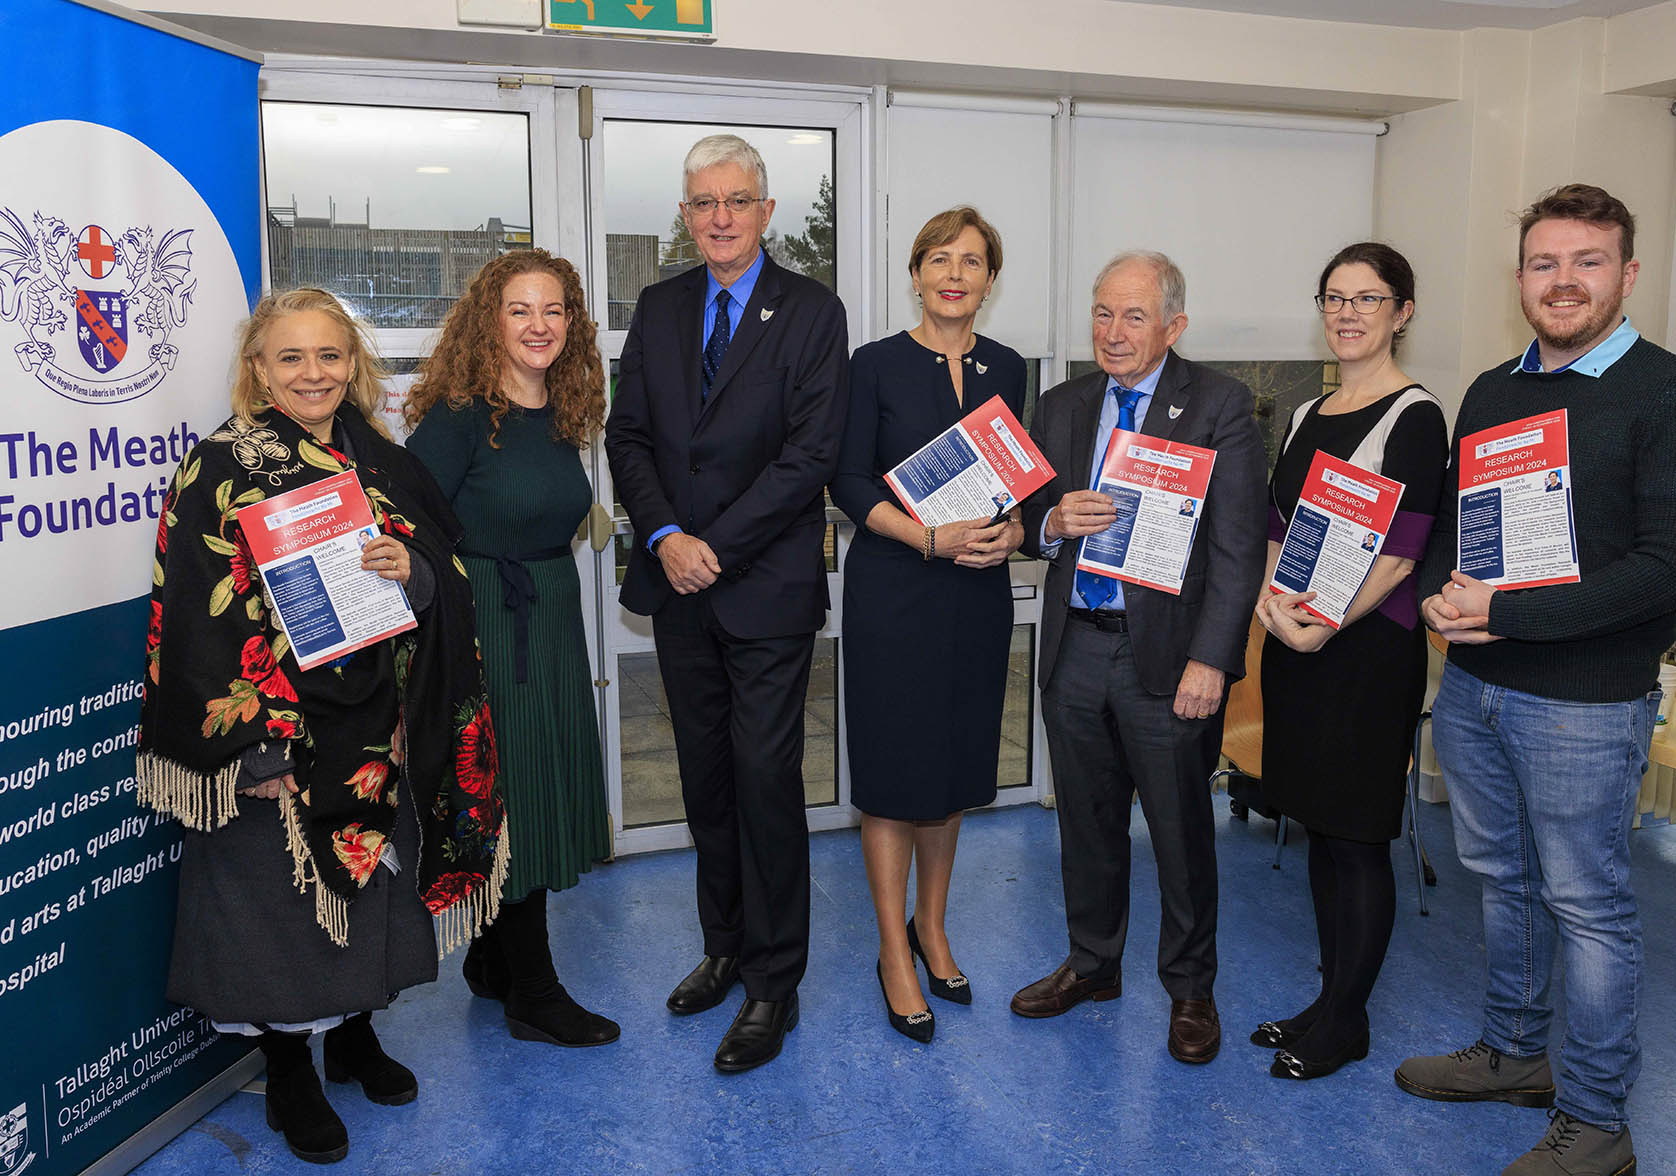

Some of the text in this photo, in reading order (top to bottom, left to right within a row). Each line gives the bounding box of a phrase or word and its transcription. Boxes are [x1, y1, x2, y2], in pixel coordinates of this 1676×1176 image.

[0, 421, 200, 479] The Meath
[971, 429, 1004, 471] SYMPOSIUM
[1000, 469, 1015, 487] 2024
[986, 432, 1017, 472] RESEARCH
[1484, 448, 1532, 468] RESEARCH
[1133, 462, 1179, 479] RESEARCH
[1168, 481, 1187, 492] 2024
[1472, 457, 1546, 483] SYMPOSIUM 2024
[1311, 492, 1373, 525] SYMPOSIUM 2024
[1325, 486, 1365, 510] RESEARCH
[272, 519, 353, 555] SYMPOSIUM 2024
[282, 512, 336, 538] RESEARCH
[56, 747, 87, 774] the
[61, 785, 110, 818] class
[86, 814, 150, 858] quality
[0, 918, 15, 945] d
[21, 903, 61, 935] arts
[67, 886, 86, 911] at
[91, 850, 164, 900] Tallaght
[55, 1041, 128, 1099] Tallaght
[58, 1067, 129, 1127] Ospidéal
[132, 1030, 194, 1077] Ollscoile
[61, 1133, 73, 1145] An
[74, 1106, 111, 1135] Academic
[112, 1086, 140, 1110] Partner
[141, 1078, 150, 1091] of
[150, 1064, 172, 1085] Trinity
[173, 1047, 199, 1068] College
